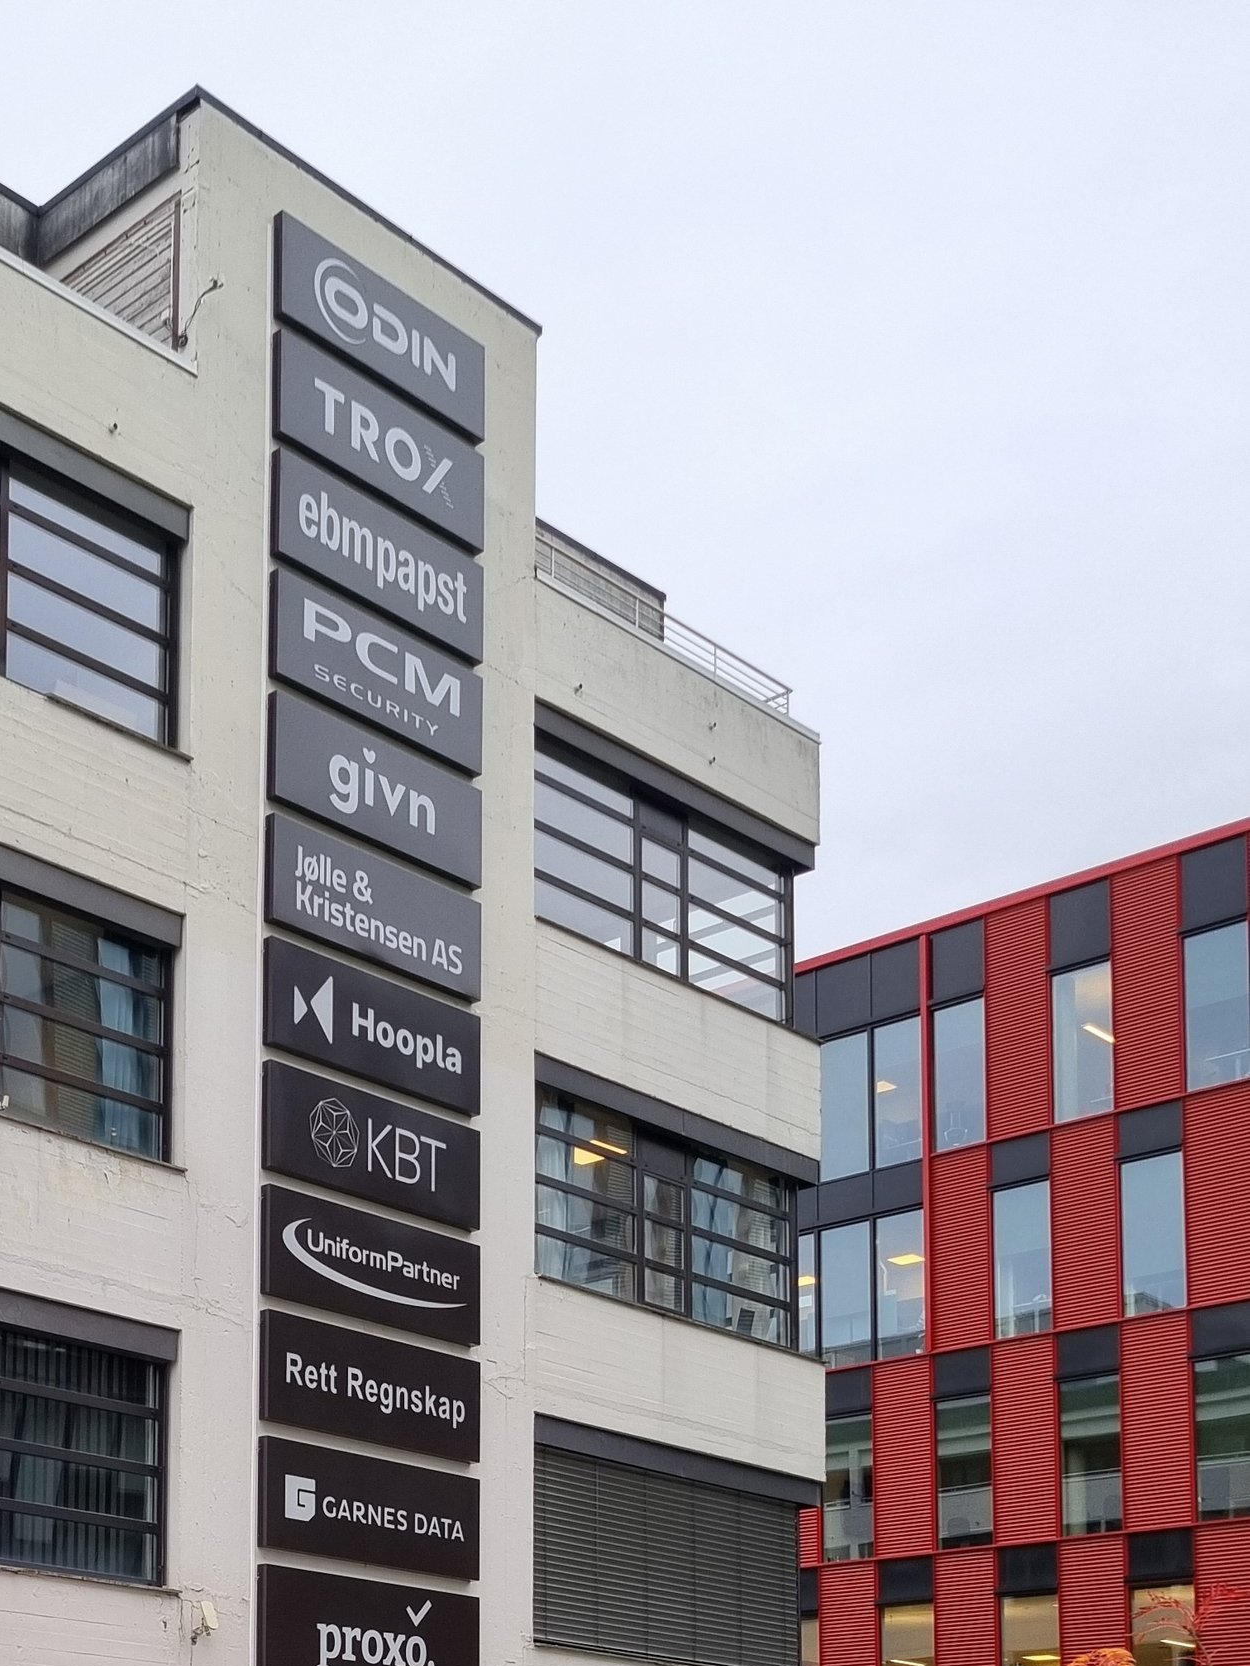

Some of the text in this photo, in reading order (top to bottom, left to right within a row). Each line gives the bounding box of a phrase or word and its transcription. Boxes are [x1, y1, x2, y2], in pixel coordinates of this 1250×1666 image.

[321, 275, 456, 392] ODIN
[314, 376, 454, 509] TROX
[298, 491, 467, 624] ebmpapst
[303, 597, 461, 718] PCM
[314, 662, 439, 737] SECURITY
[328, 747, 436, 835] givn
[295, 846, 374, 905] Jølle &
[295, 880, 463, 975] Kristensen AS
[351, 1002, 462, 1075] Hoopla
[367, 1117, 447, 1192] KBT
[306, 1228, 460, 1291] UniformPartner
[285, 1352, 466, 1429] Rett Regnskap
[322, 1496, 465, 1542] GARNES DATA
